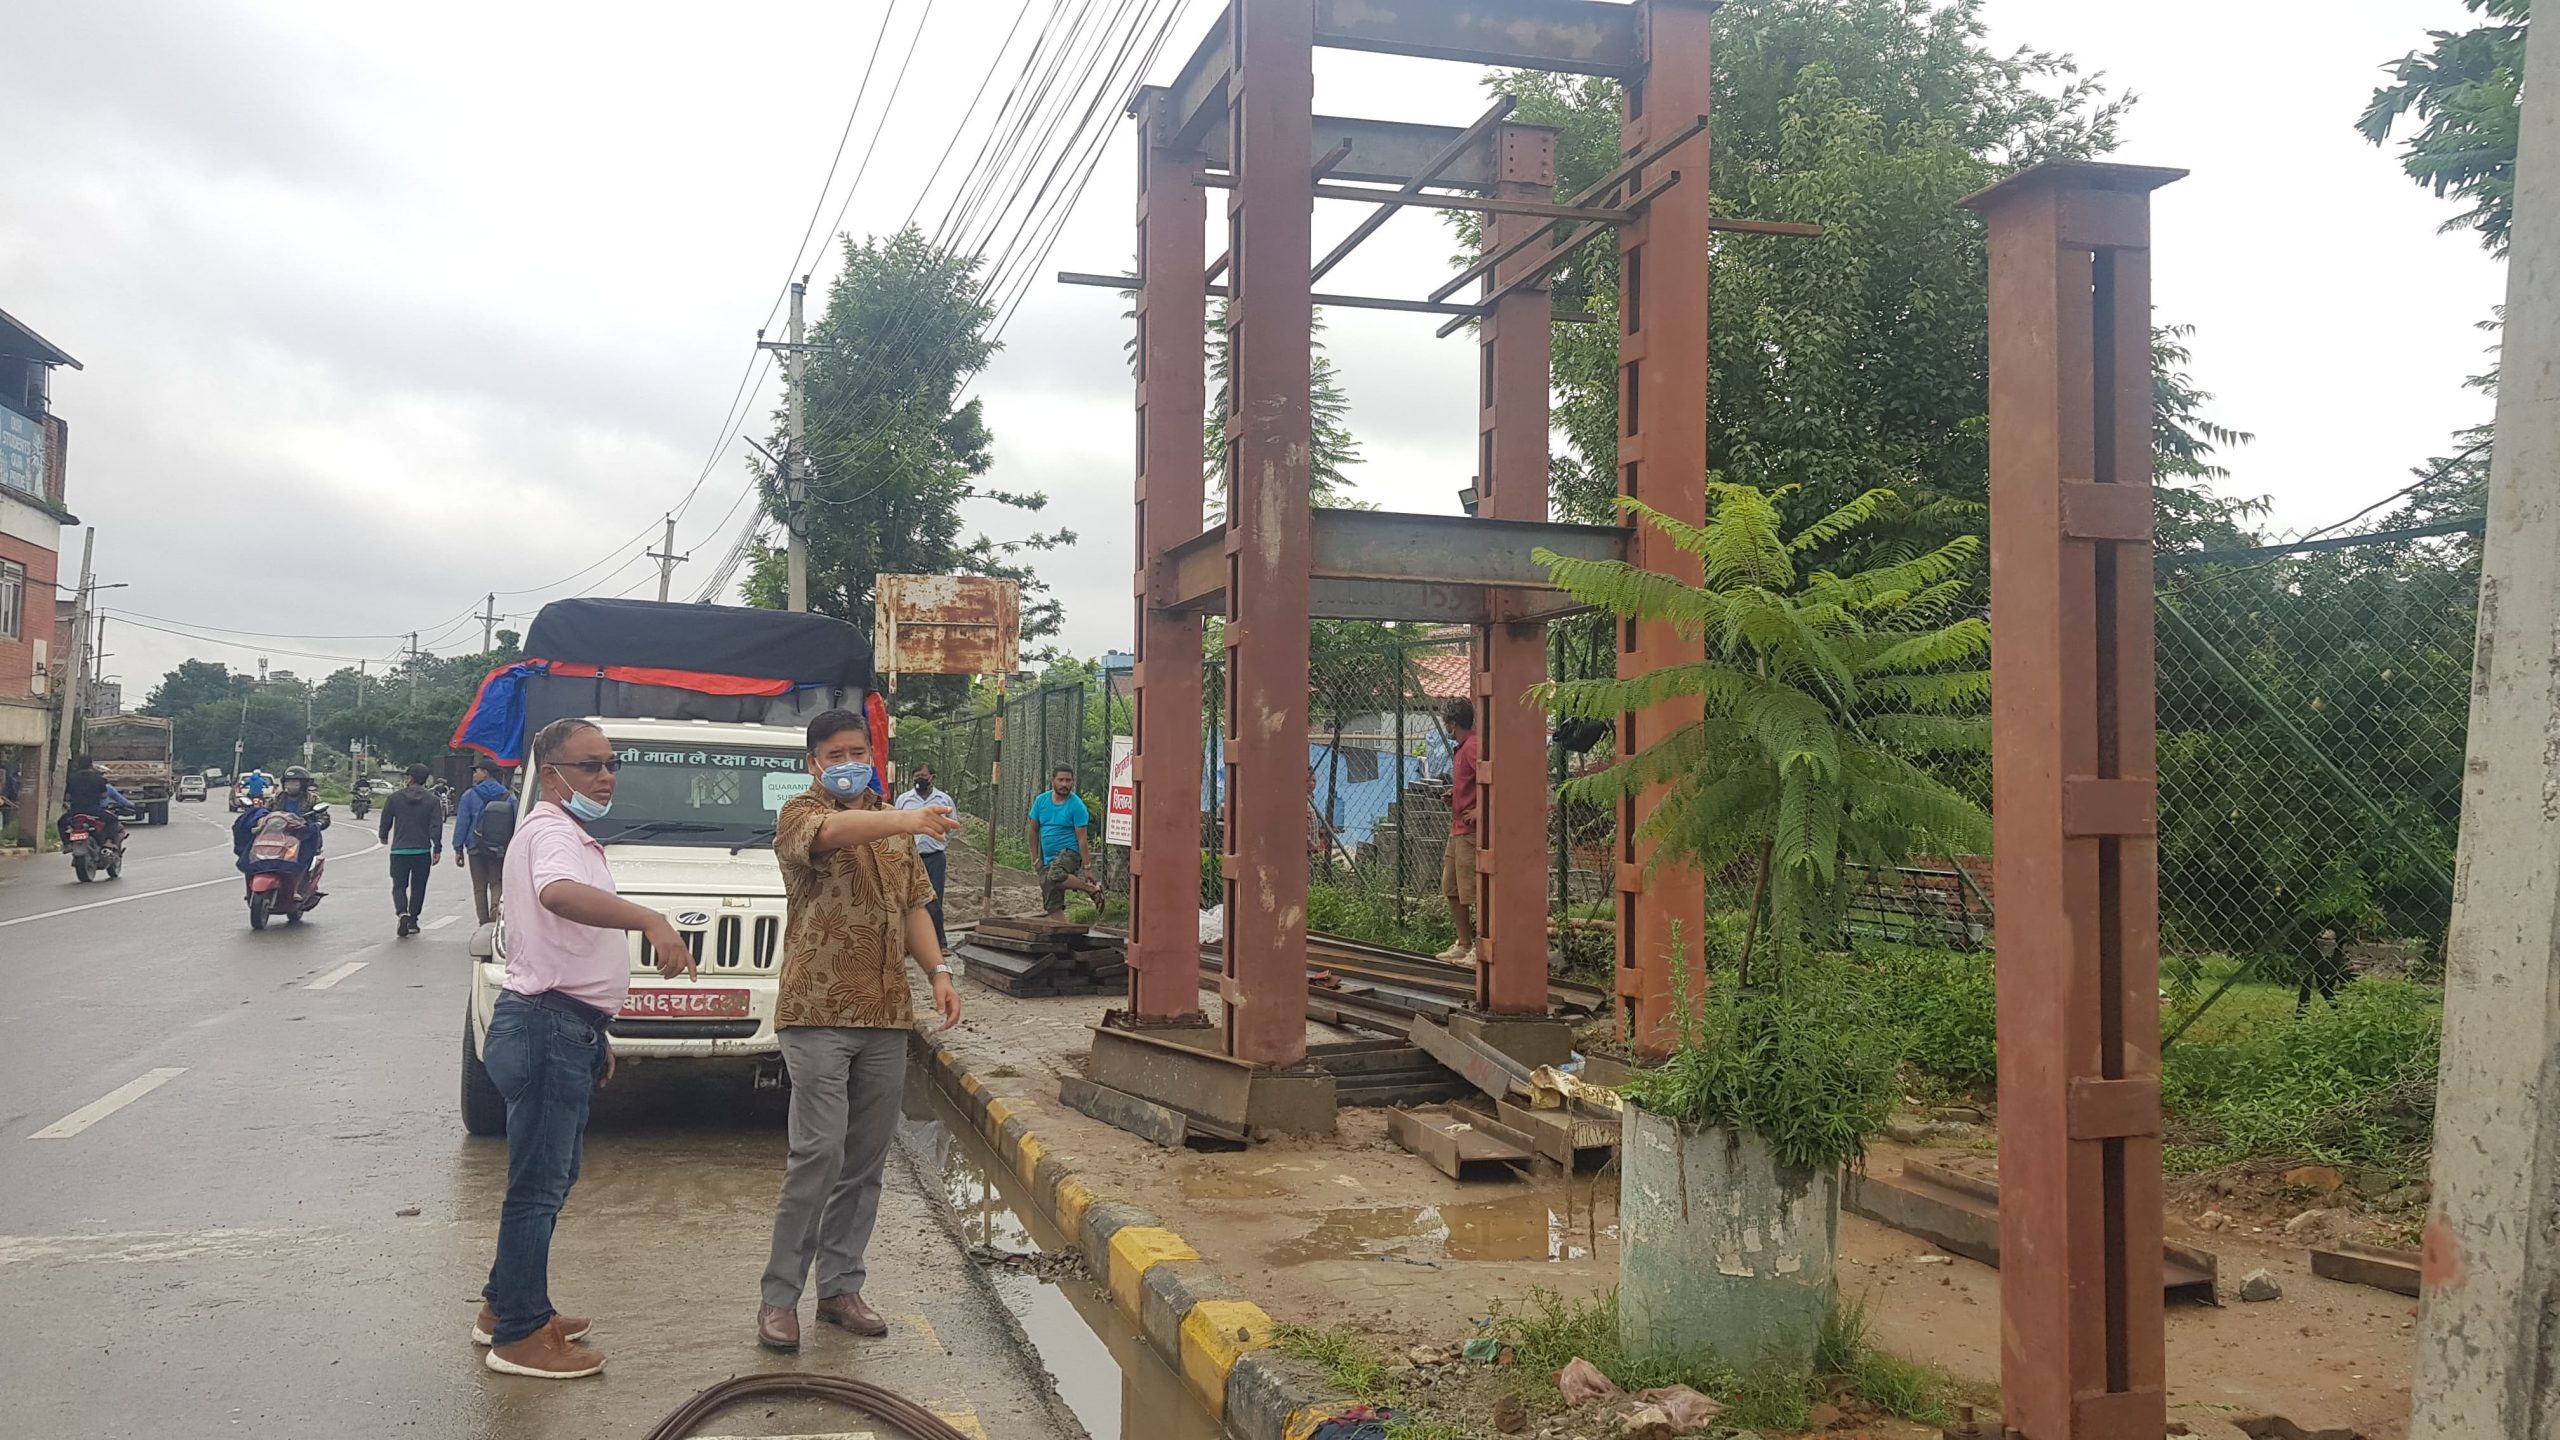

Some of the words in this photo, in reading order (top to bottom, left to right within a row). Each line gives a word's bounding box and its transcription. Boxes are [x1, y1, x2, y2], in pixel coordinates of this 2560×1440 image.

[2, 430, 31, 457] STUDENTS
[612, 748, 641, 763] ती
[644, 751, 685, 765] माता
[688, 750, 707, 765] ले
[711, 753, 747, 767] रक्षा
[768, 783, 809, 791] QUARANT
